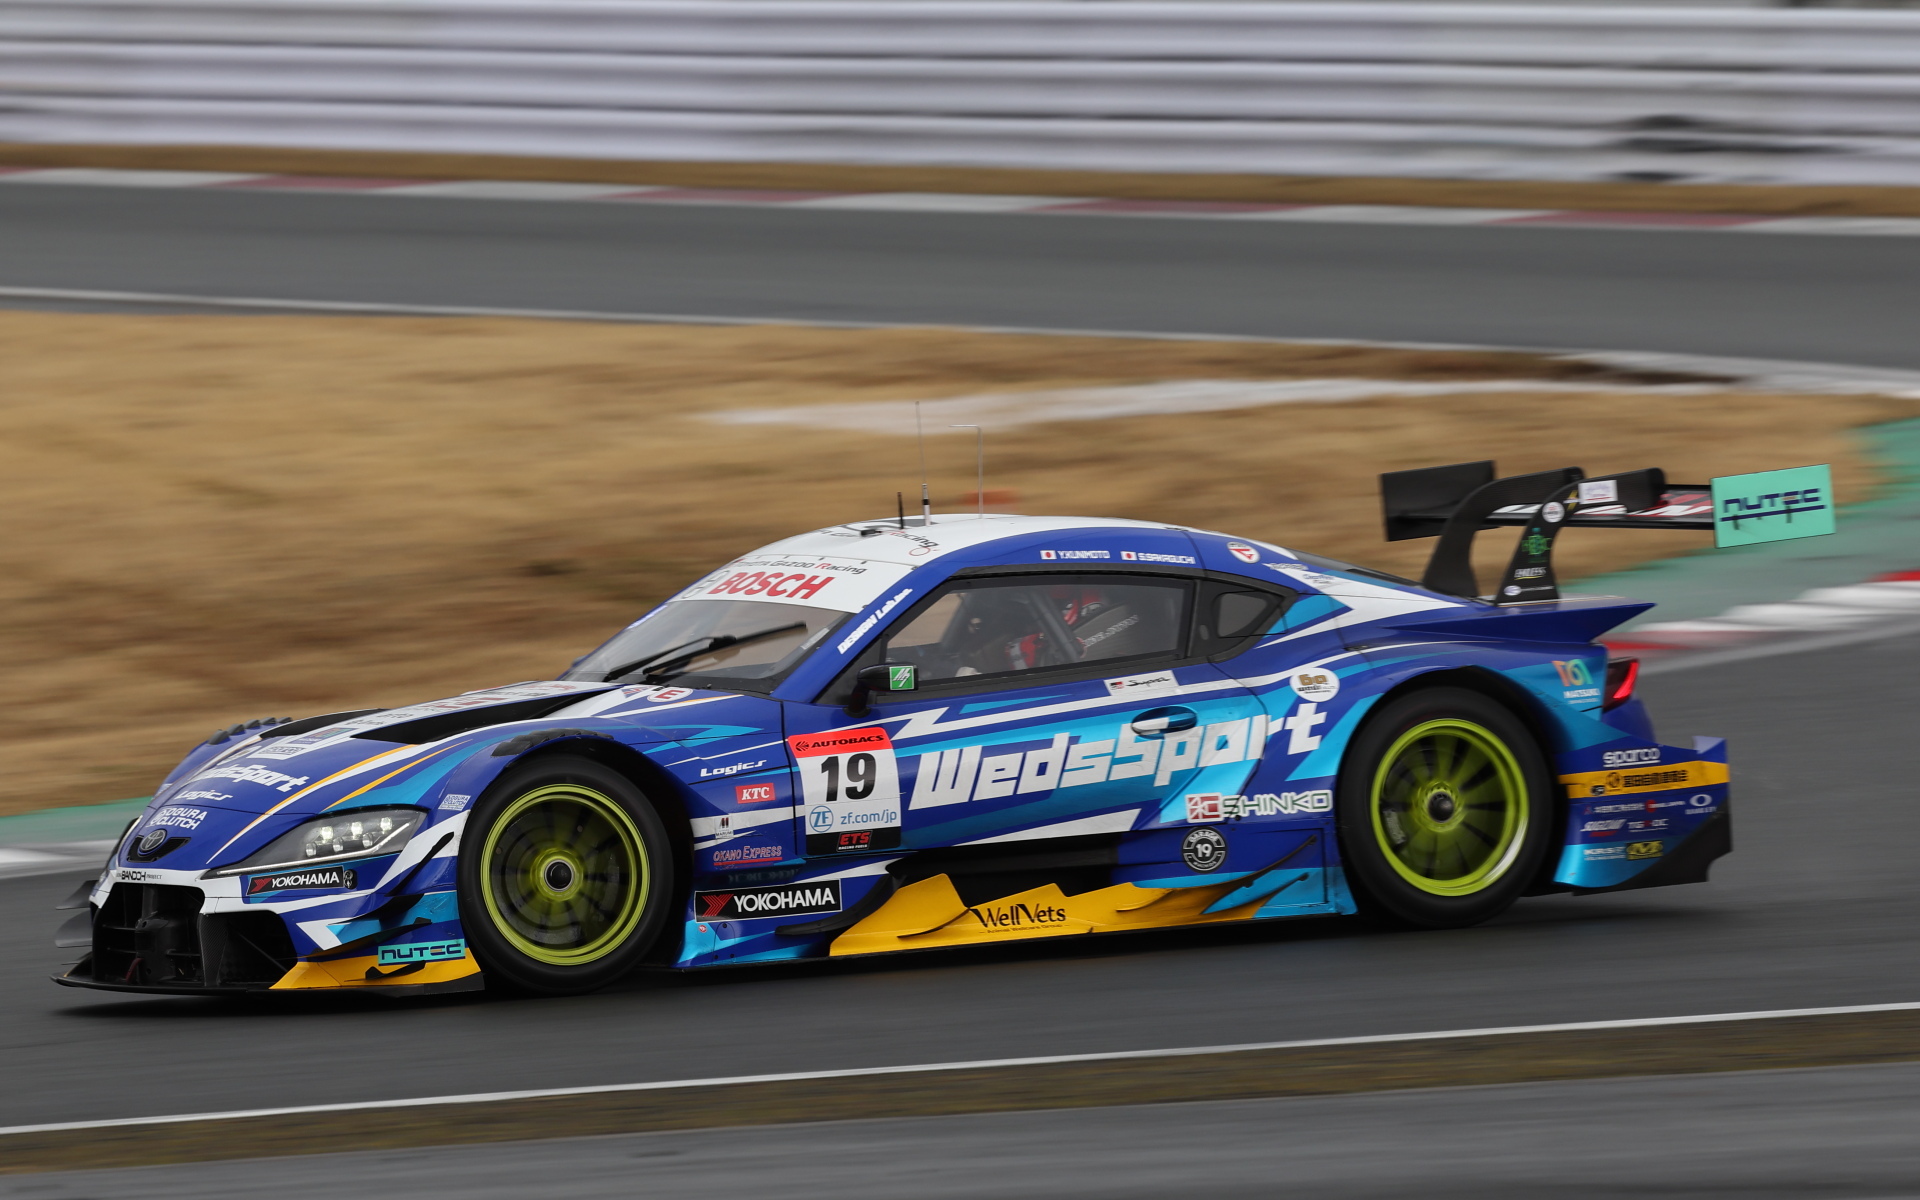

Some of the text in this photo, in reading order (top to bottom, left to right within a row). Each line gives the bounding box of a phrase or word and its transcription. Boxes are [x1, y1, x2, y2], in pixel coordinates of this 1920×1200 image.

[1724, 488, 1820, 513] NUTEC
[815, 562, 867, 575] Racing
[707, 571, 836, 600] BOSCH
[811, 735, 885, 749] AUTOBACS
[908, 703, 1328, 811] WedsSport
[1602, 747, 1661, 767] sparco
[700, 759, 767, 778] Logics
[821, 752, 877, 802] 19
[174, 789, 234, 801] Logics
[741, 786, 770, 801] KTC
[1222, 791, 1333, 816] SHINKO
[167, 808, 208, 821] OGURA
[811, 809, 898, 828] ZF zf.com/jp
[158, 817, 201, 830] CLUTCH
[840, 832, 871, 846] ETS
[713, 849, 742, 861] OKANO
[1195, 843, 1213, 858] 19
[271, 871, 340, 888] YOKOHAMA
[733, 887, 835, 912] YOKOHAMA
[381, 943, 463, 961] NUTEC
